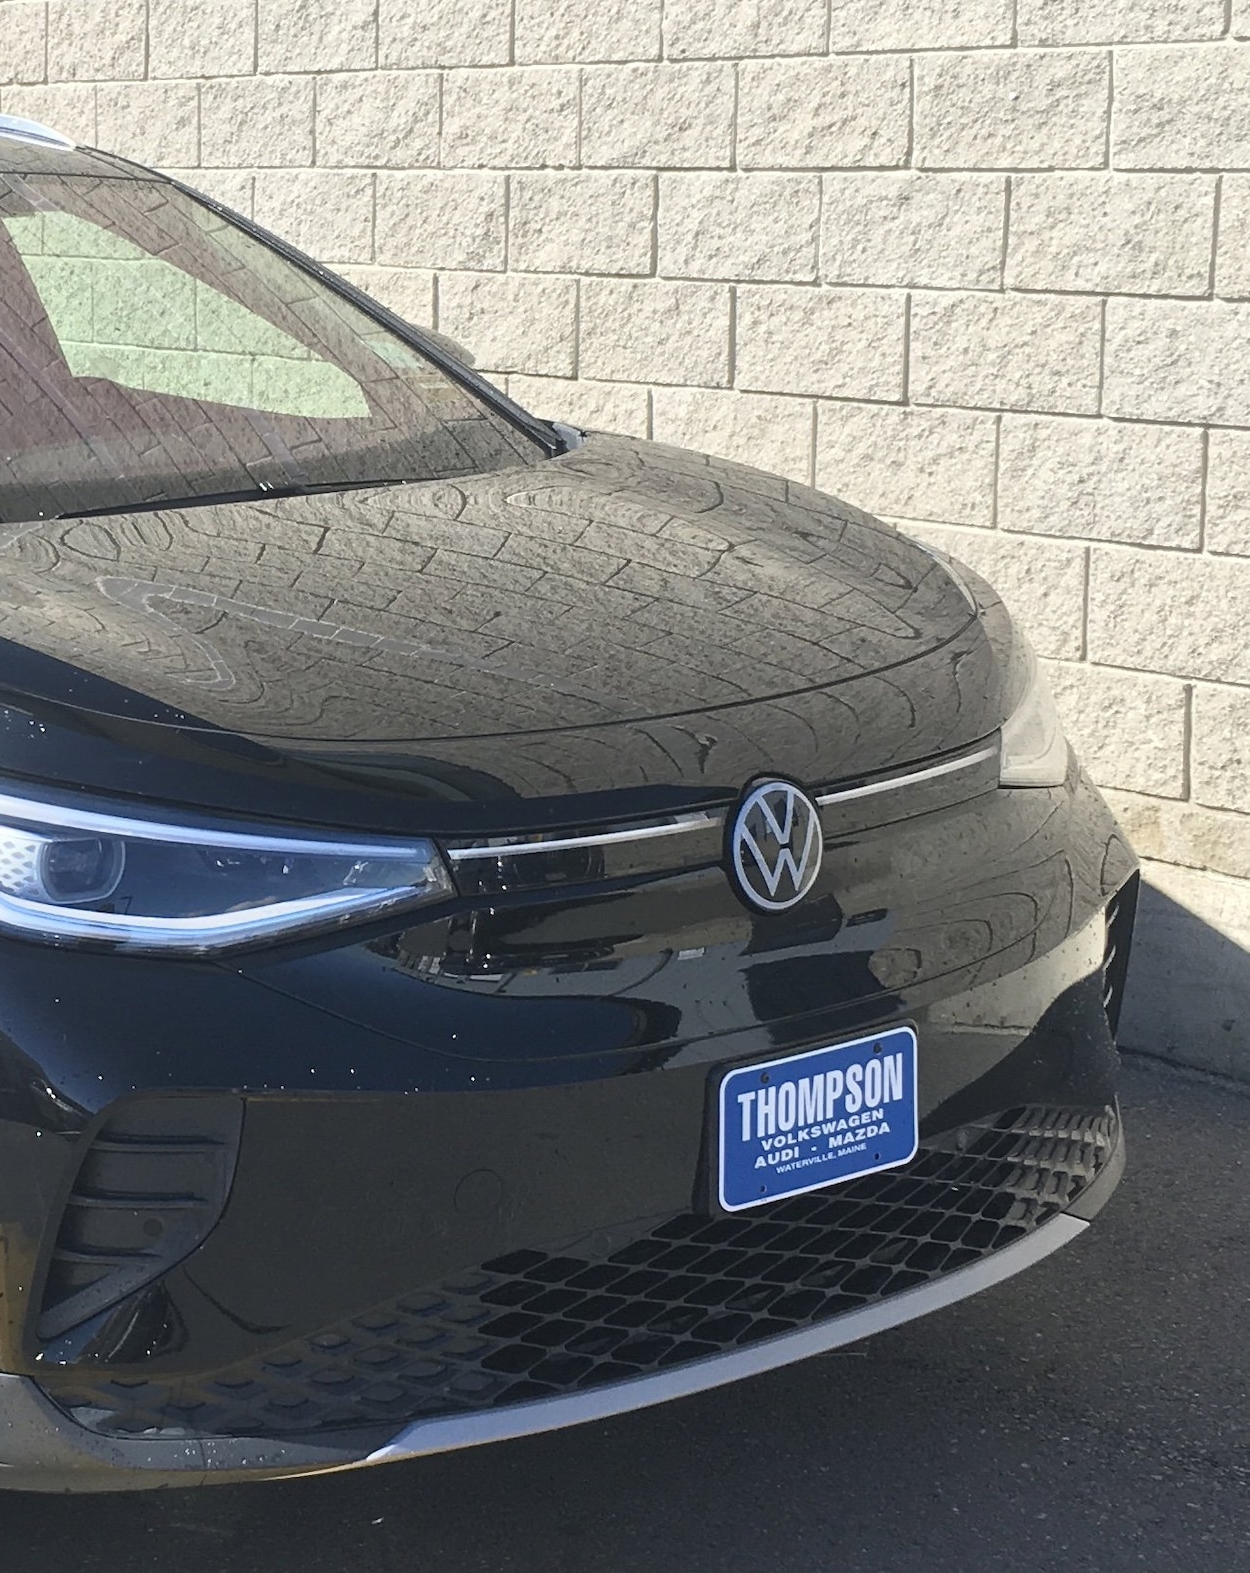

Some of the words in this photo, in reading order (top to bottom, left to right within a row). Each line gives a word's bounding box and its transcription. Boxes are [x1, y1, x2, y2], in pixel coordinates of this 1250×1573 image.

[737, 1052, 904, 1142] THOMPSON
[754, 1146, 800, 1169] AUDI
[828, 1122, 891, 1149] MAZDA
[761, 1108, 884, 1151] VOLKSWAGEN
[838, 1143, 867, 1160] MAINE
